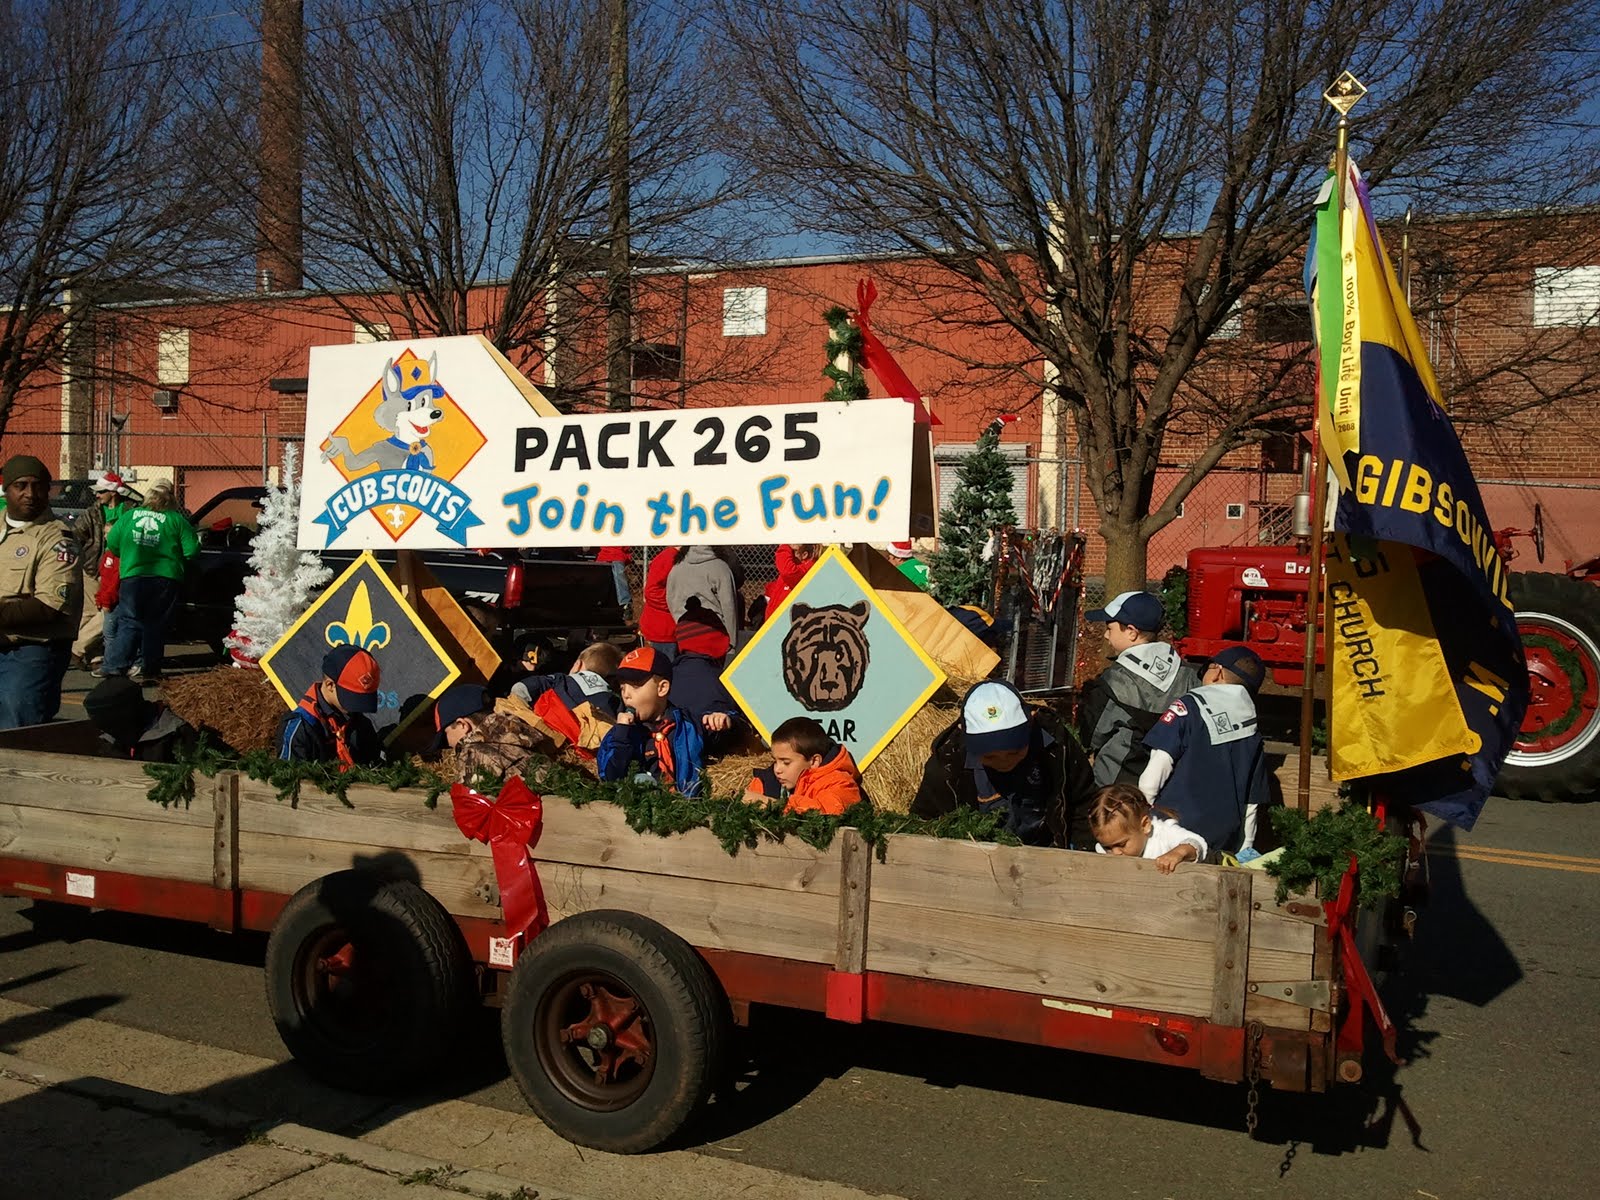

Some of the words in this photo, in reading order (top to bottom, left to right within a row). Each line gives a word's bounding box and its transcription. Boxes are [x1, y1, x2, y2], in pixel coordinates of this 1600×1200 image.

[1345, 277, 1355, 316] 100%
[1340, 355, 1355, 381] Life
[1339, 387, 1353, 416] Unit
[514, 419, 677, 473] PACK
[693, 412, 821, 466] 265
[331, 478, 379, 522] CUB
[380, 473, 466, 522] SCOUTS
[501, 482, 625, 537] Join
[647, 489, 739, 538] the
[758, 475, 892, 530] Fun!
[1355, 454, 1515, 612] GIBSONVIL
[1328, 581, 1386, 699] CHURCH
